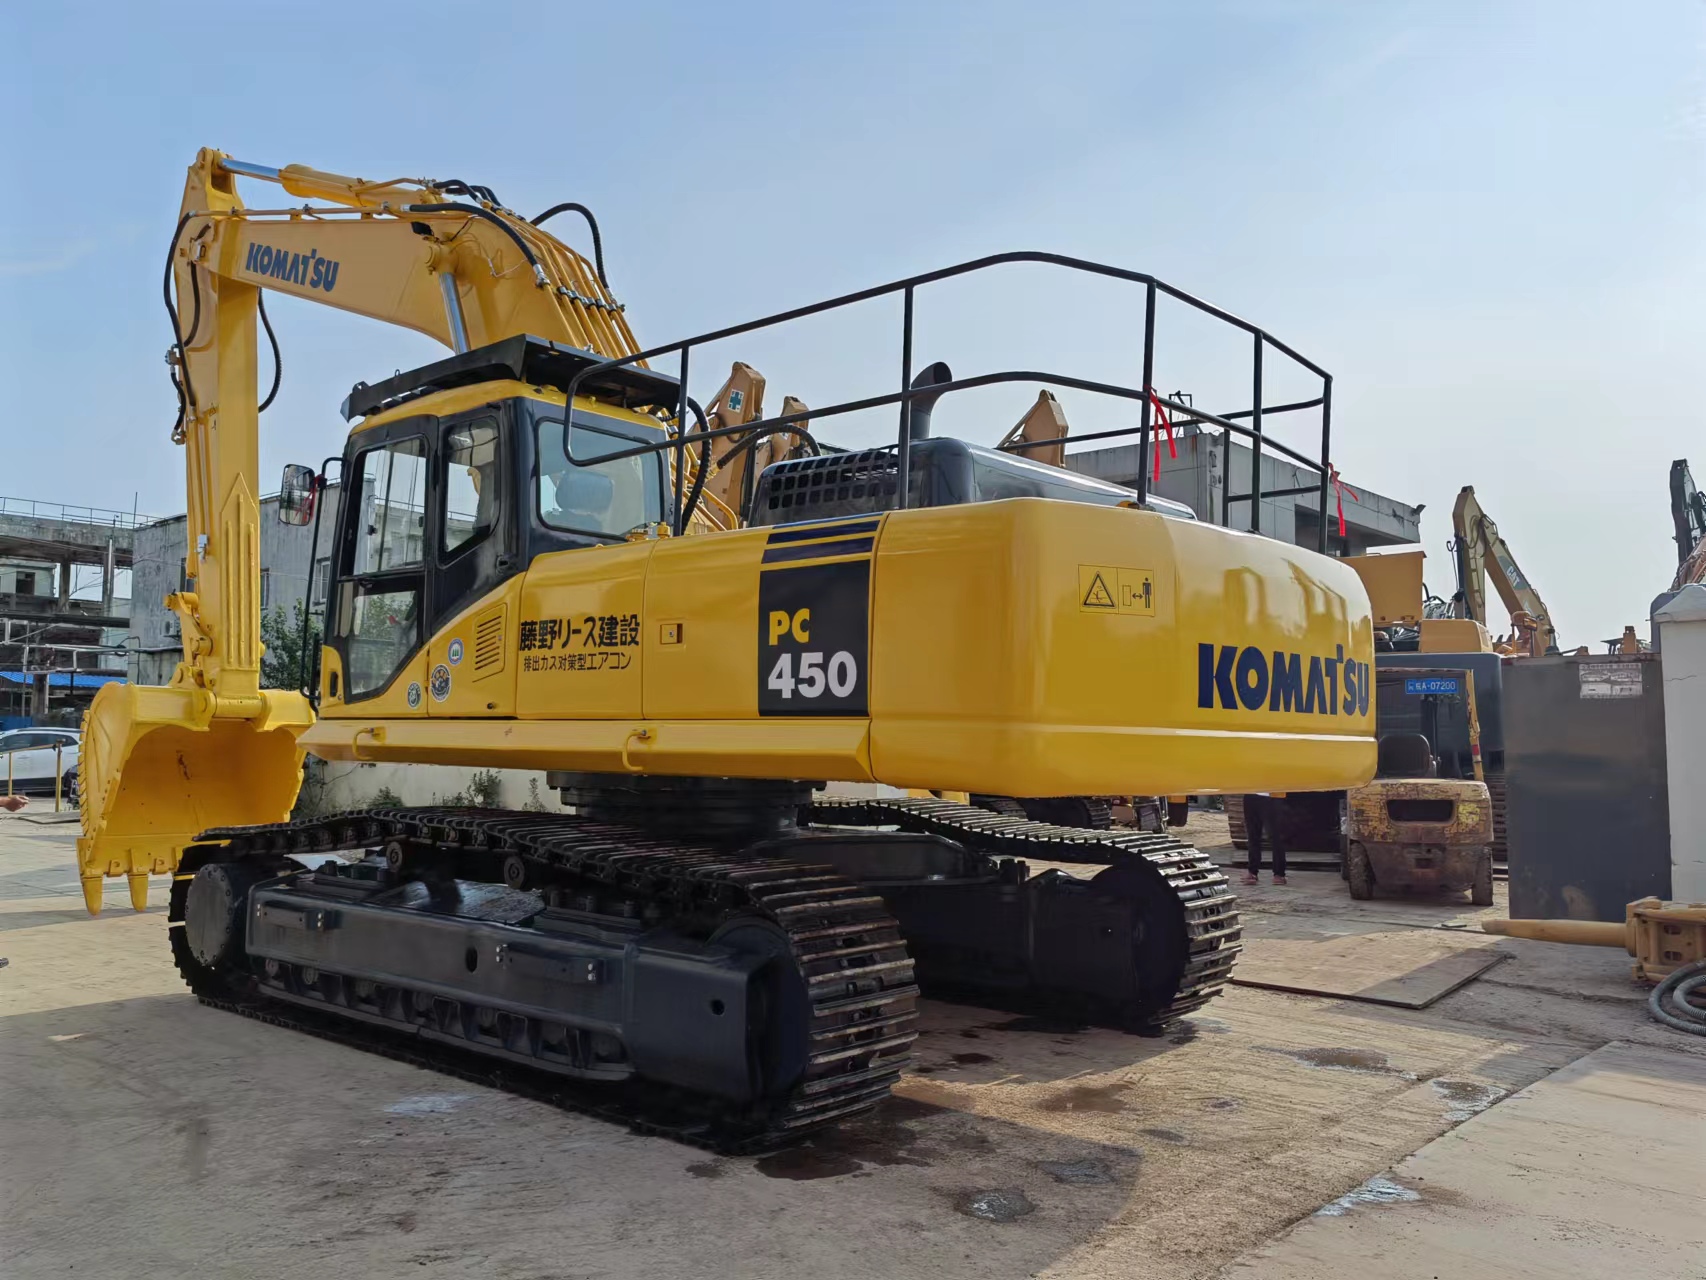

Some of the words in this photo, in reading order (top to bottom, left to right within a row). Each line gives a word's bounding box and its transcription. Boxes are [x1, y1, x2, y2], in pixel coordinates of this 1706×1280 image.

[245, 242, 340, 292] KOMATSU
[1506, 565, 1520, 587] CAT
[519, 614, 640, 651] 藤野リース建設
[768, 608, 810, 646] PC
[767, 650, 857, 699] 450
[1197, 642, 1370, 717] KOMATSU
